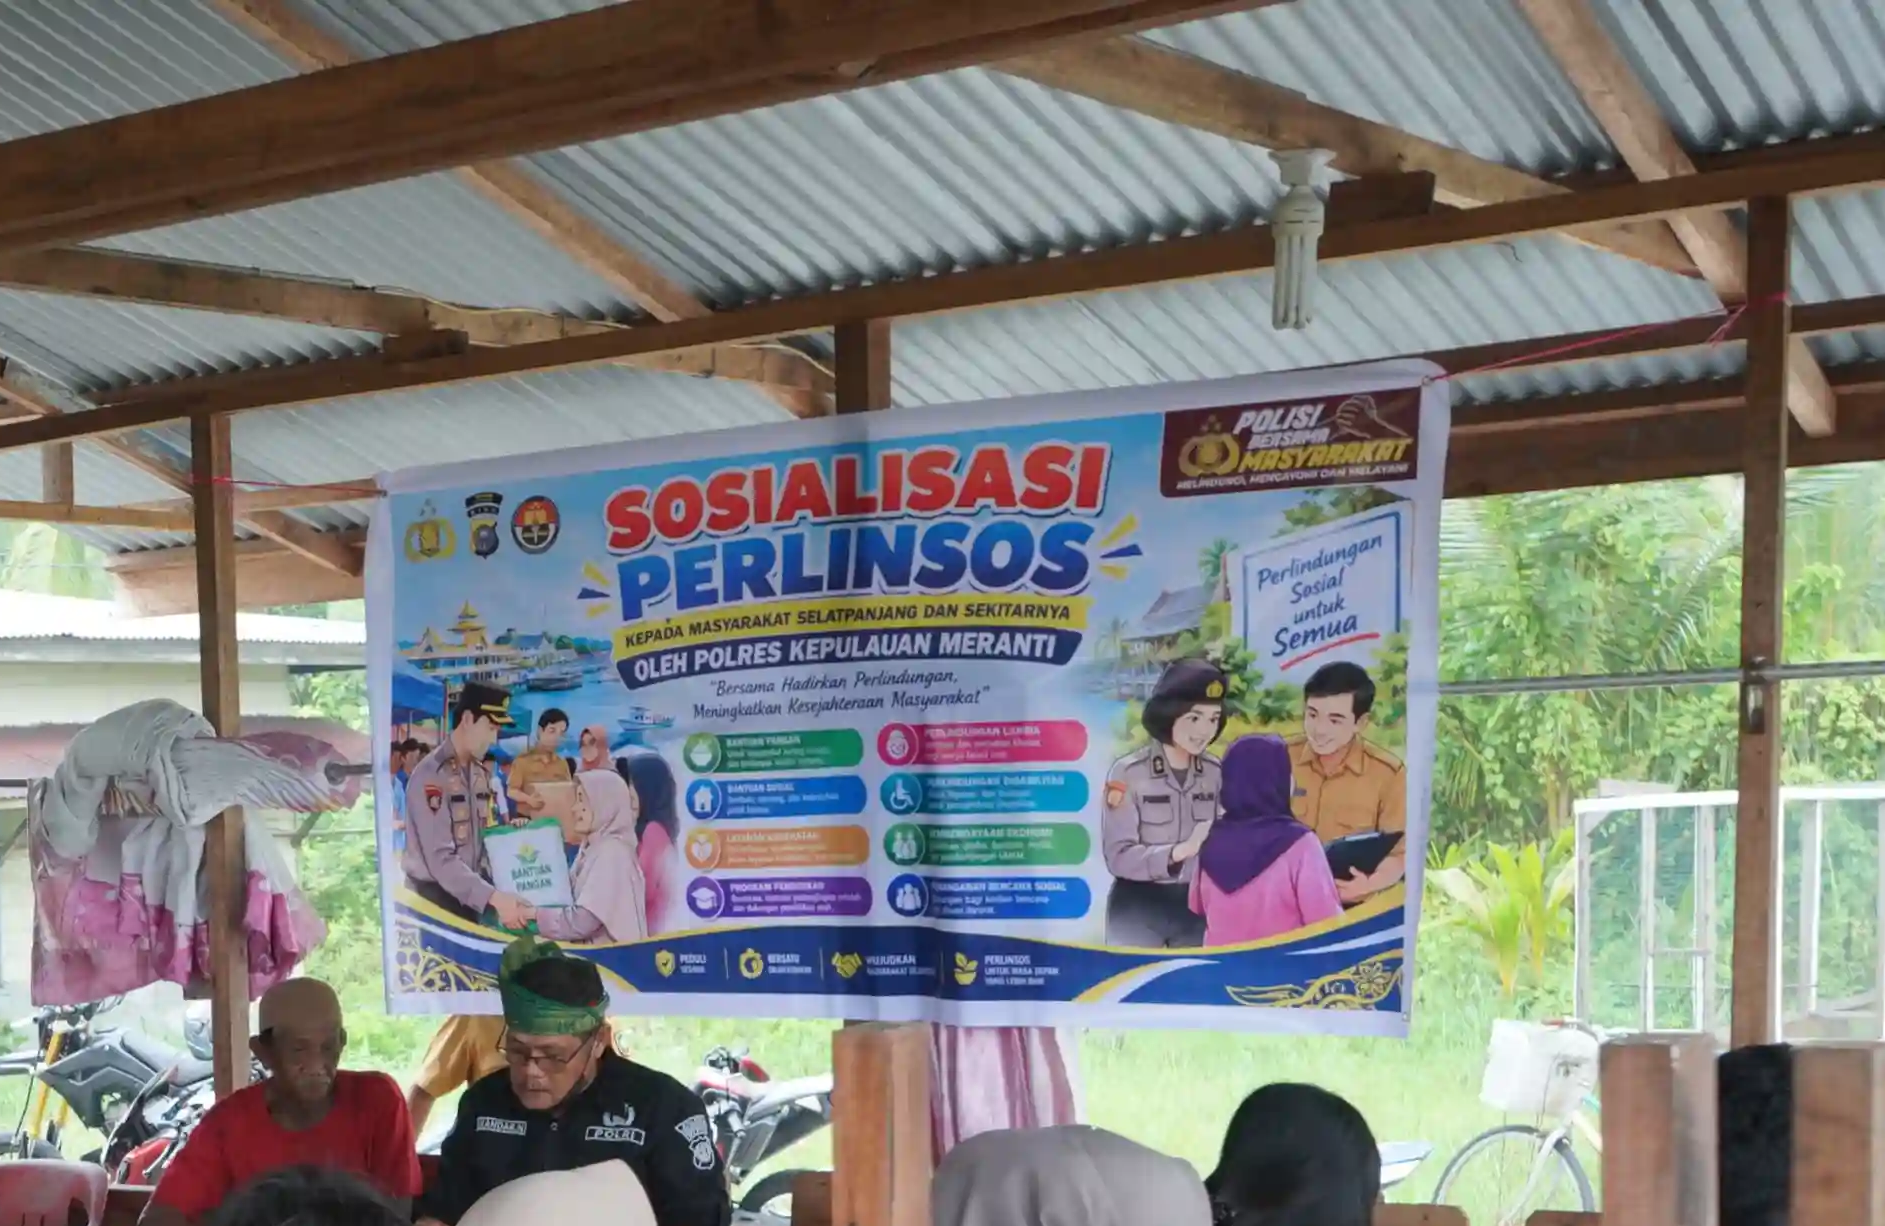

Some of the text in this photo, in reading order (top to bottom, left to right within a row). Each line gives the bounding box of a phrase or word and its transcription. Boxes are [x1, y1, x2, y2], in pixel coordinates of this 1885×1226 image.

[1233, 403, 1325, 435] POLISI
[1238, 438, 1413, 473] MASYARAKAT
[1247, 427, 1331, 450] BERSAMA
[605, 444, 1106, 550] SOSIALISASI
[617, 520, 1095, 621] PERLINSOS
[1257, 535, 1382, 592] Perlindungan
[1290, 566, 1345, 604] Sosial
[625, 603, 1071, 648] KEPADA MASYARAKAT SELATPANJANG DAN SEKITARNYA
[1293, 592, 1346, 625] untuk
[1272, 614, 1358, 658] Semua
[633, 631, 1058, 682] OLEH POLRES KEPULAUAN MERANTI
[781, 676, 847, 692] Hadirkan
[854, 670, 958, 689] Perlindungan,
[693, 701, 782, 722] Meningkatkan
[788, 696, 884, 718] Kesejahteraan
[511, 863, 553, 881] BANTUAN
[515, 878, 552, 893] PANGAN
[594, 1128, 635, 1142] POLRI
